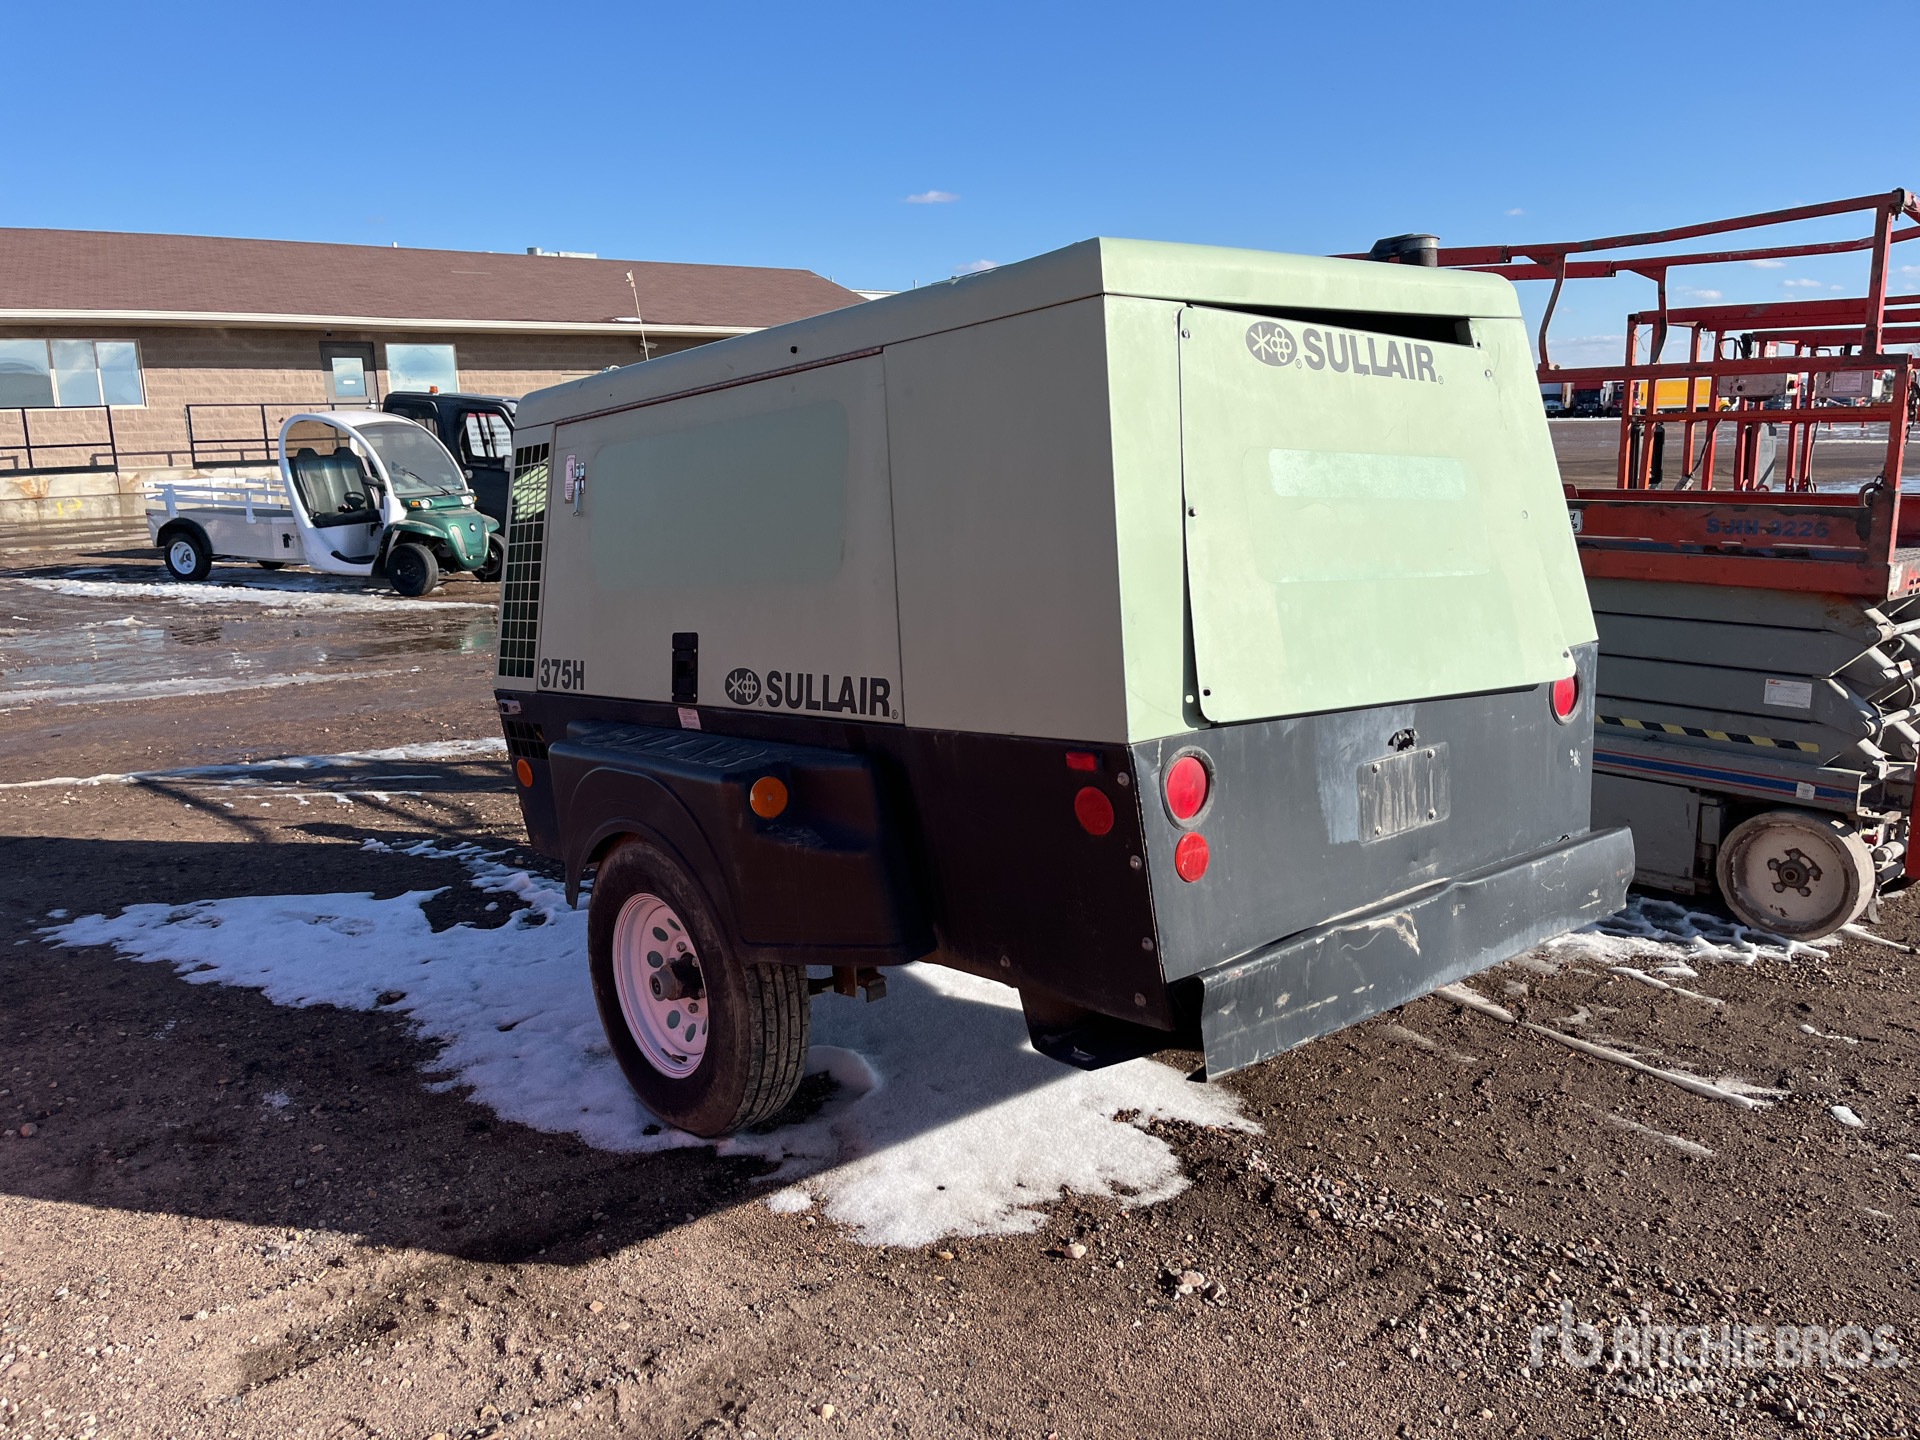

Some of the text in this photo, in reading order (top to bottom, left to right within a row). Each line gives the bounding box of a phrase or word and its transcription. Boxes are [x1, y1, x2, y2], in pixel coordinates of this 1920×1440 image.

[1302, 328, 1437, 382] SULLAIR
[540, 657, 585, 690] 375H
[765, 670, 891, 717] SULLAIR
